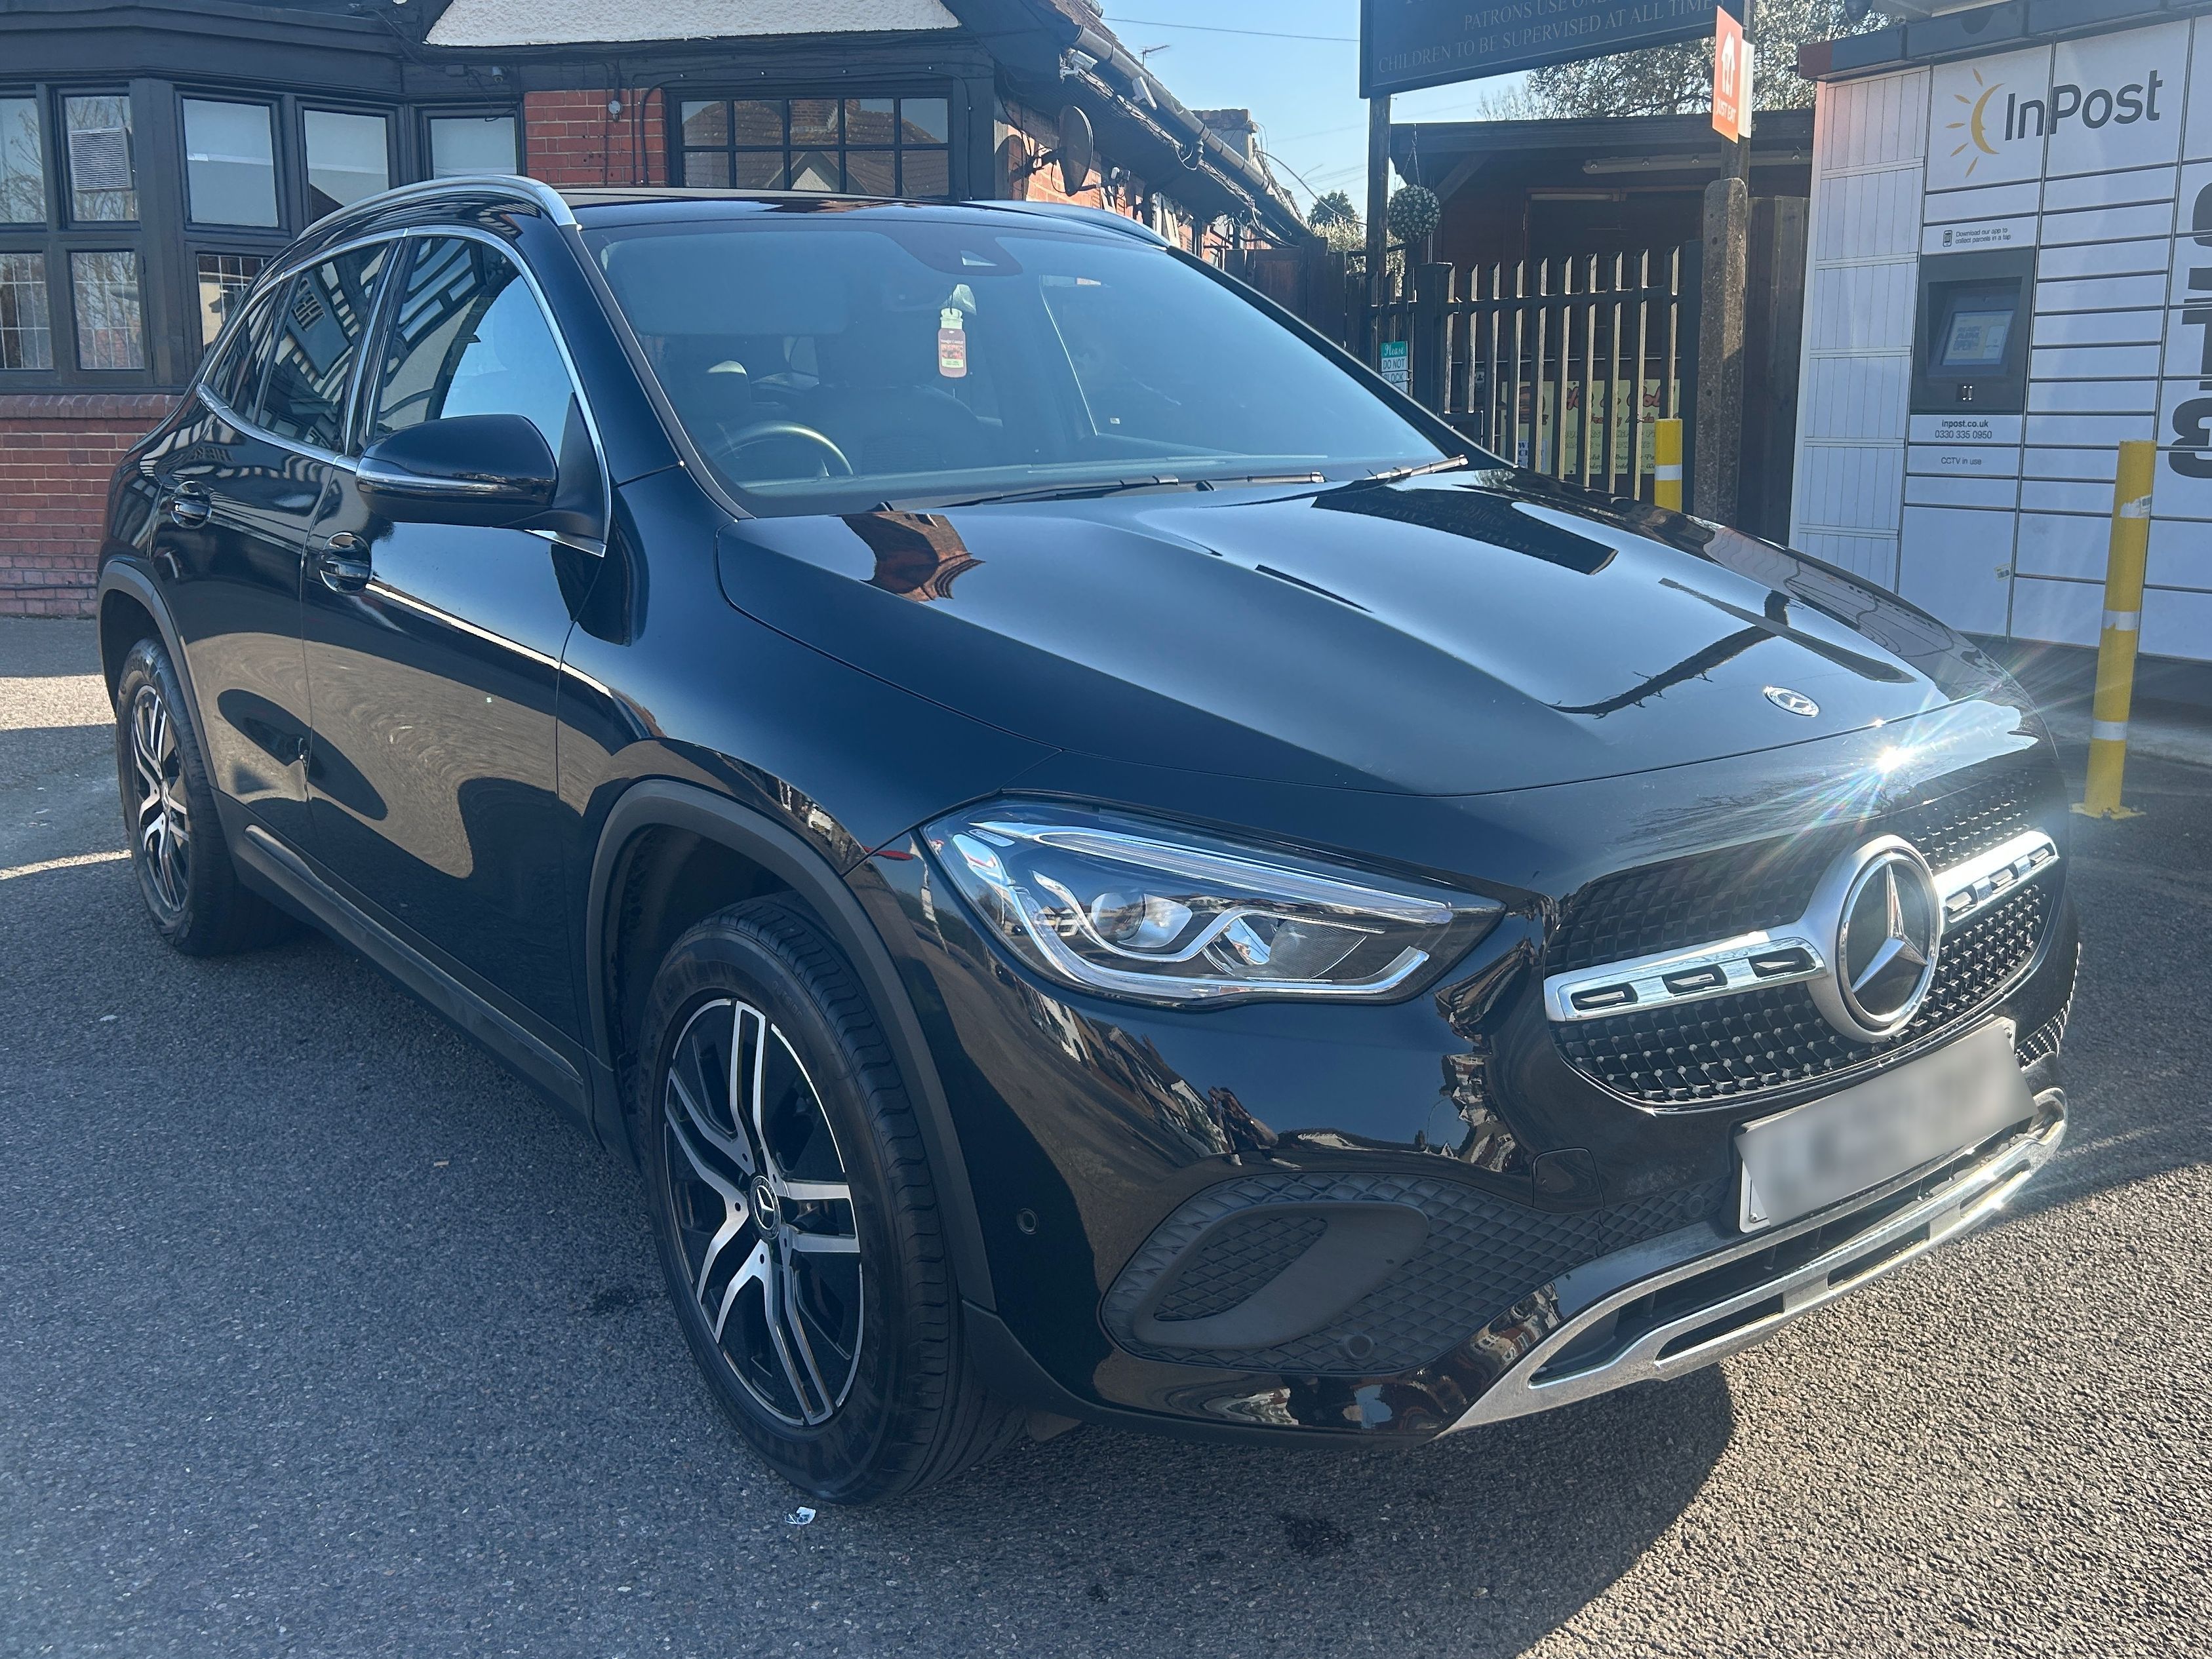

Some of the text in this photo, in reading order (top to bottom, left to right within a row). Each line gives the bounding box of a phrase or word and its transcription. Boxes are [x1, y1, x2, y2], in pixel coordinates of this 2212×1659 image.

[1464, 1, 1531, 31] PATRONS
[1379, 45, 1451, 73] CHILDREN
[1456, 39, 1474, 58] TO
[1480, 35, 1497, 54] BE
[1503, 14, 1601, 49] SUPERVISED
[1605, 9, 1627, 29] AT
[1629, 2, 1664, 22] ALL
[1716, 96, 1737, 124] JUST EAT
[2004, 69, 2163, 141] InPost
[1383, 344, 1405, 357] Please
[1383, 358, 1405, 370] DO NOT
[1935, 430, 1954, 439] 0330
[1941, 420, 1989, 429] inpost.co.uk
